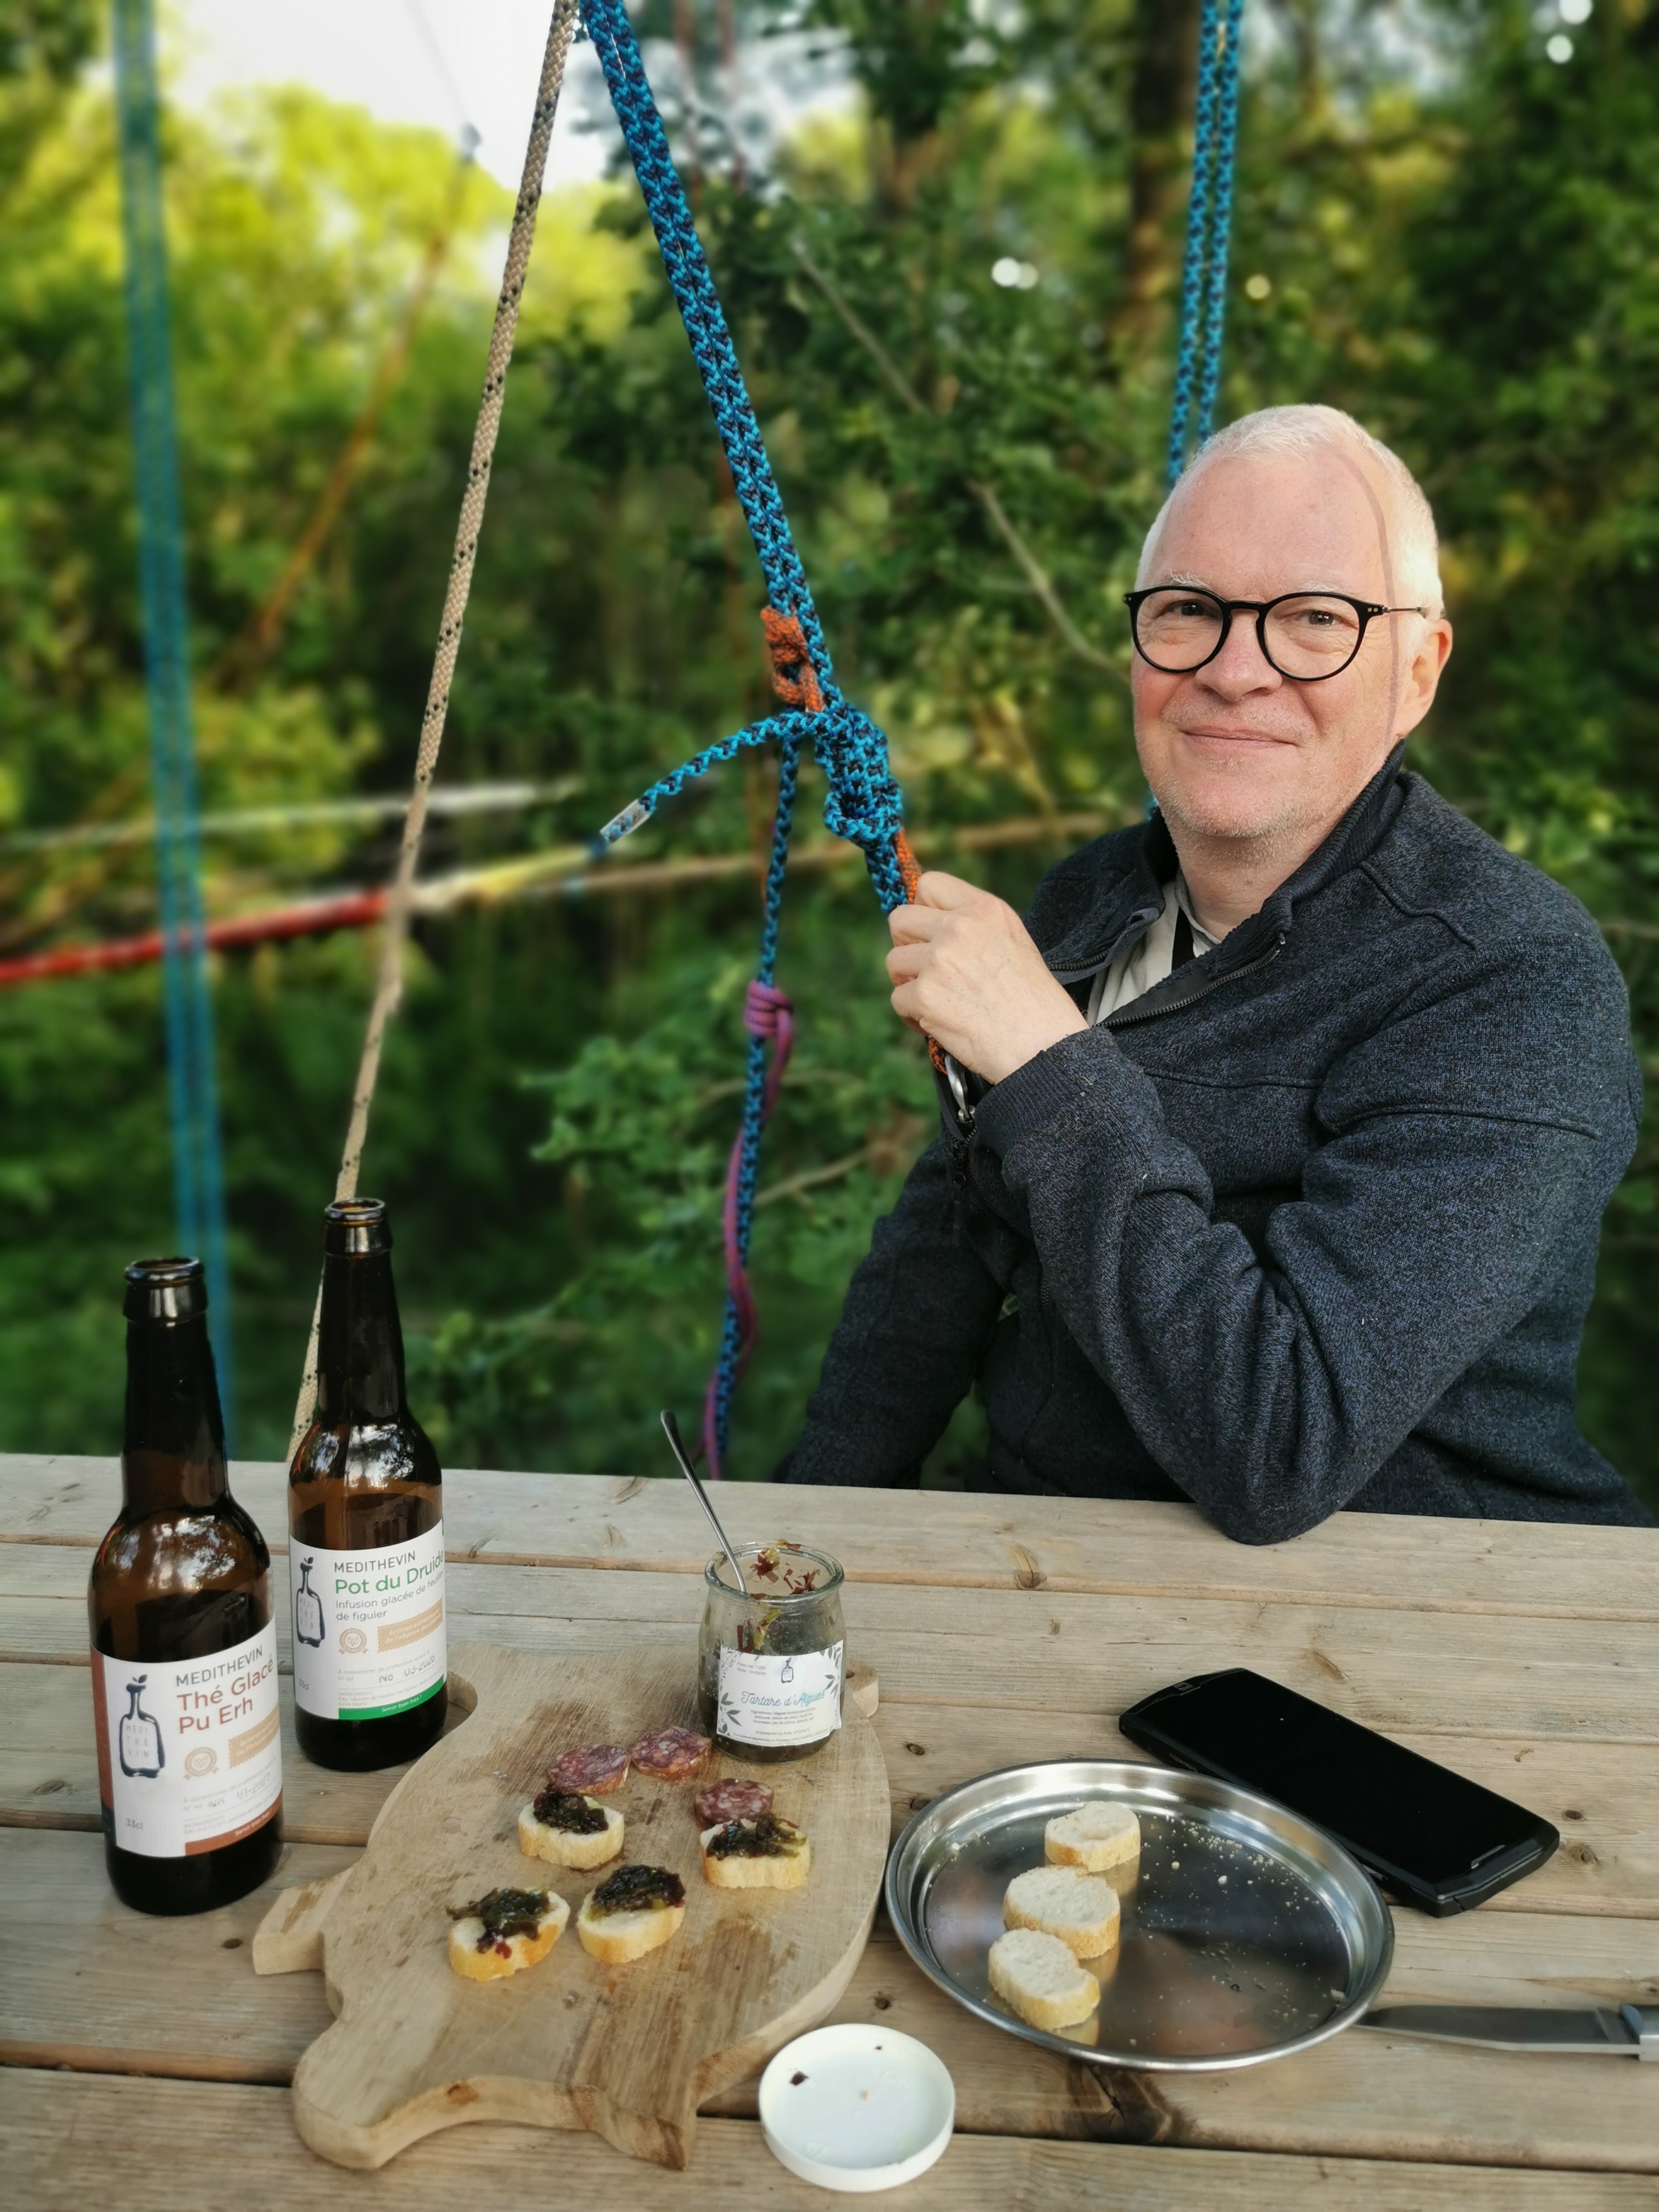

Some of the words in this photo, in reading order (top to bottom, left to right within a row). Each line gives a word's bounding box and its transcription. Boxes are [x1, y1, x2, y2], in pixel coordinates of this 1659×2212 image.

[335, 1550, 415, 1573] MEDITHEVIN
[335, 1579, 369, 1594] Pot
[375, 1575, 400, 1592] du
[407, 1550, 444, 1584] Druide
[336, 1600, 377, 1609] Infusion
[381, 1591, 414, 1607] glacée
[416, 1585, 426, 1595] de
[336, 1612, 349, 1621] de
[353, 1610, 387, 1622] figuier
[176, 1644, 263, 1687] MEDITHEVIN
[177, 1684, 224, 1711] Thé
[231, 1654, 273, 1696] Glacé
[741, 1691, 782, 1707] Tartare
[179, 1715, 210, 1734] Pu
[219, 1697, 253, 1725] Erh
[126, 1818, 144, 1831] 33cl
